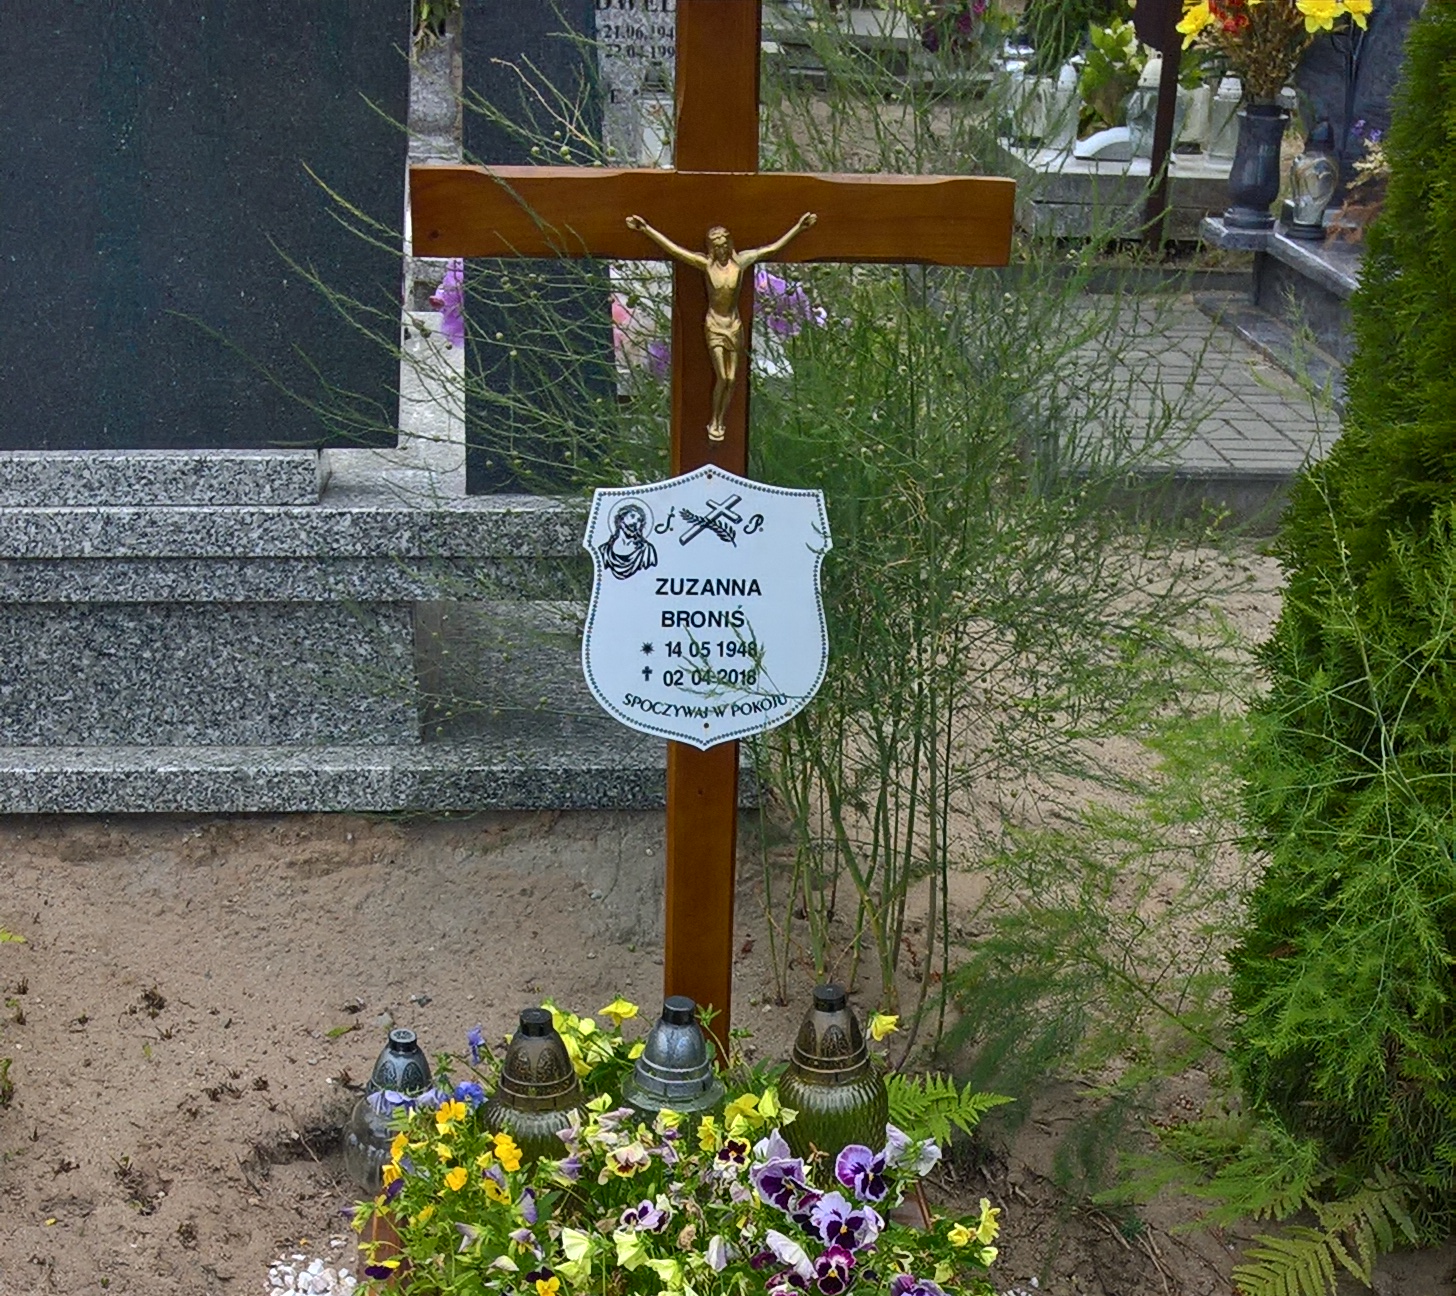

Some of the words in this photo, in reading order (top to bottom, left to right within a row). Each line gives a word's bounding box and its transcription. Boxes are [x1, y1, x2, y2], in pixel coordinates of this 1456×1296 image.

[602, 24, 675, 39] 21.06.194
[655, 578, 762, 596] ZUZANNA
[661, 604, 745, 628] BRONIŚ
[665, 641, 682, 658] 14
[689, 641, 711, 658] 05
[717, 640, 757, 658] 1948
[663, 670, 683, 687] 02
[717, 668, 757, 686] 2018
[622, 693, 709, 719] SPOCZYWAJ
[712, 703, 731, 718] W
[731, 692, 788, 718] POKOJU
